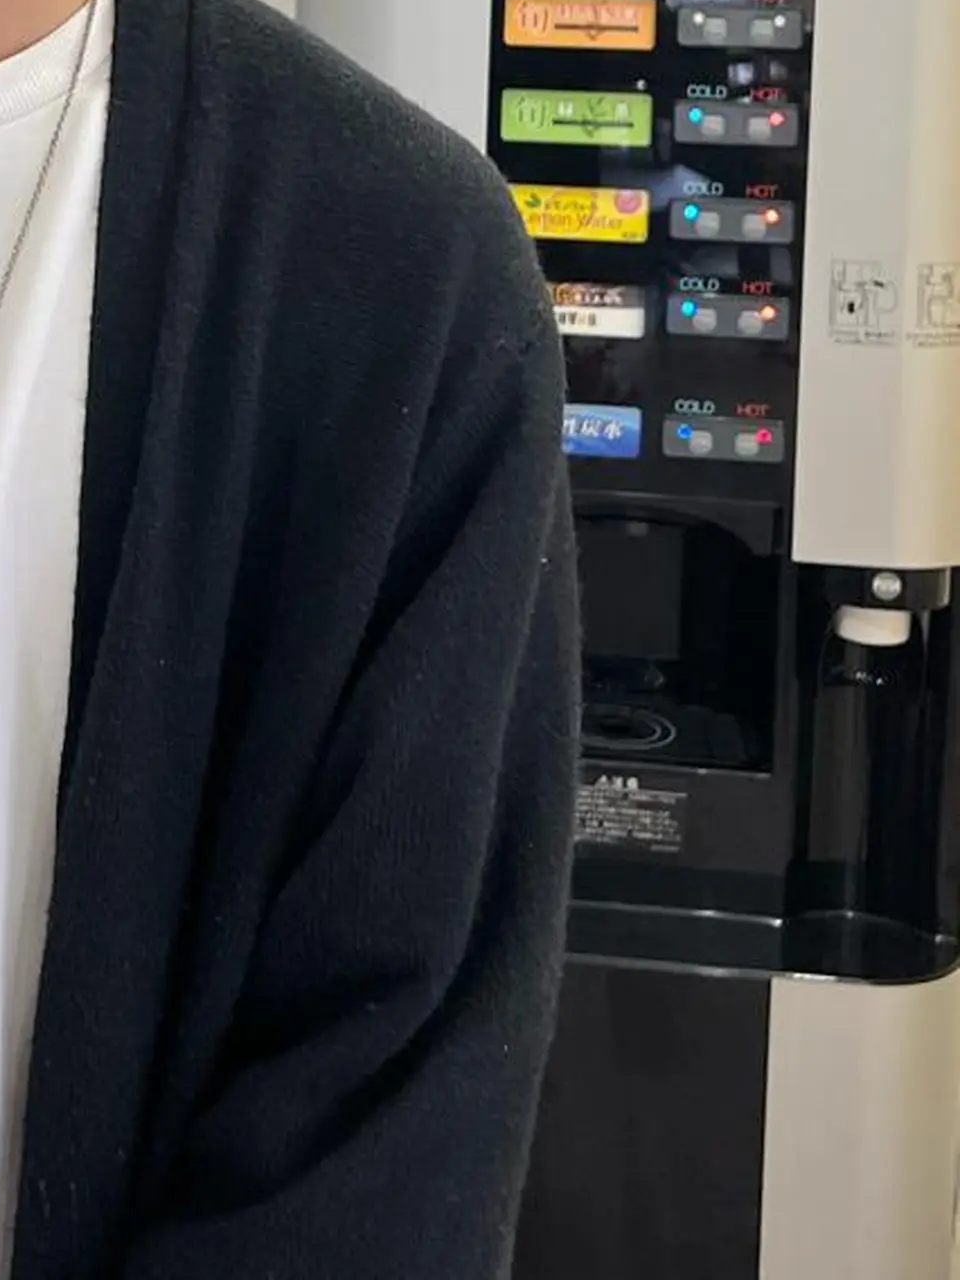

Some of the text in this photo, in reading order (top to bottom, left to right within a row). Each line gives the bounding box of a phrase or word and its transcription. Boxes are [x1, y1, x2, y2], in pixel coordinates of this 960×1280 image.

[686, 84, 782, 100] COLD HOT
[683, 182, 779, 197] COLD HOT
[680, 277, 772, 293] COLD HOT
[675, 399, 770, 416] COLD HOT
